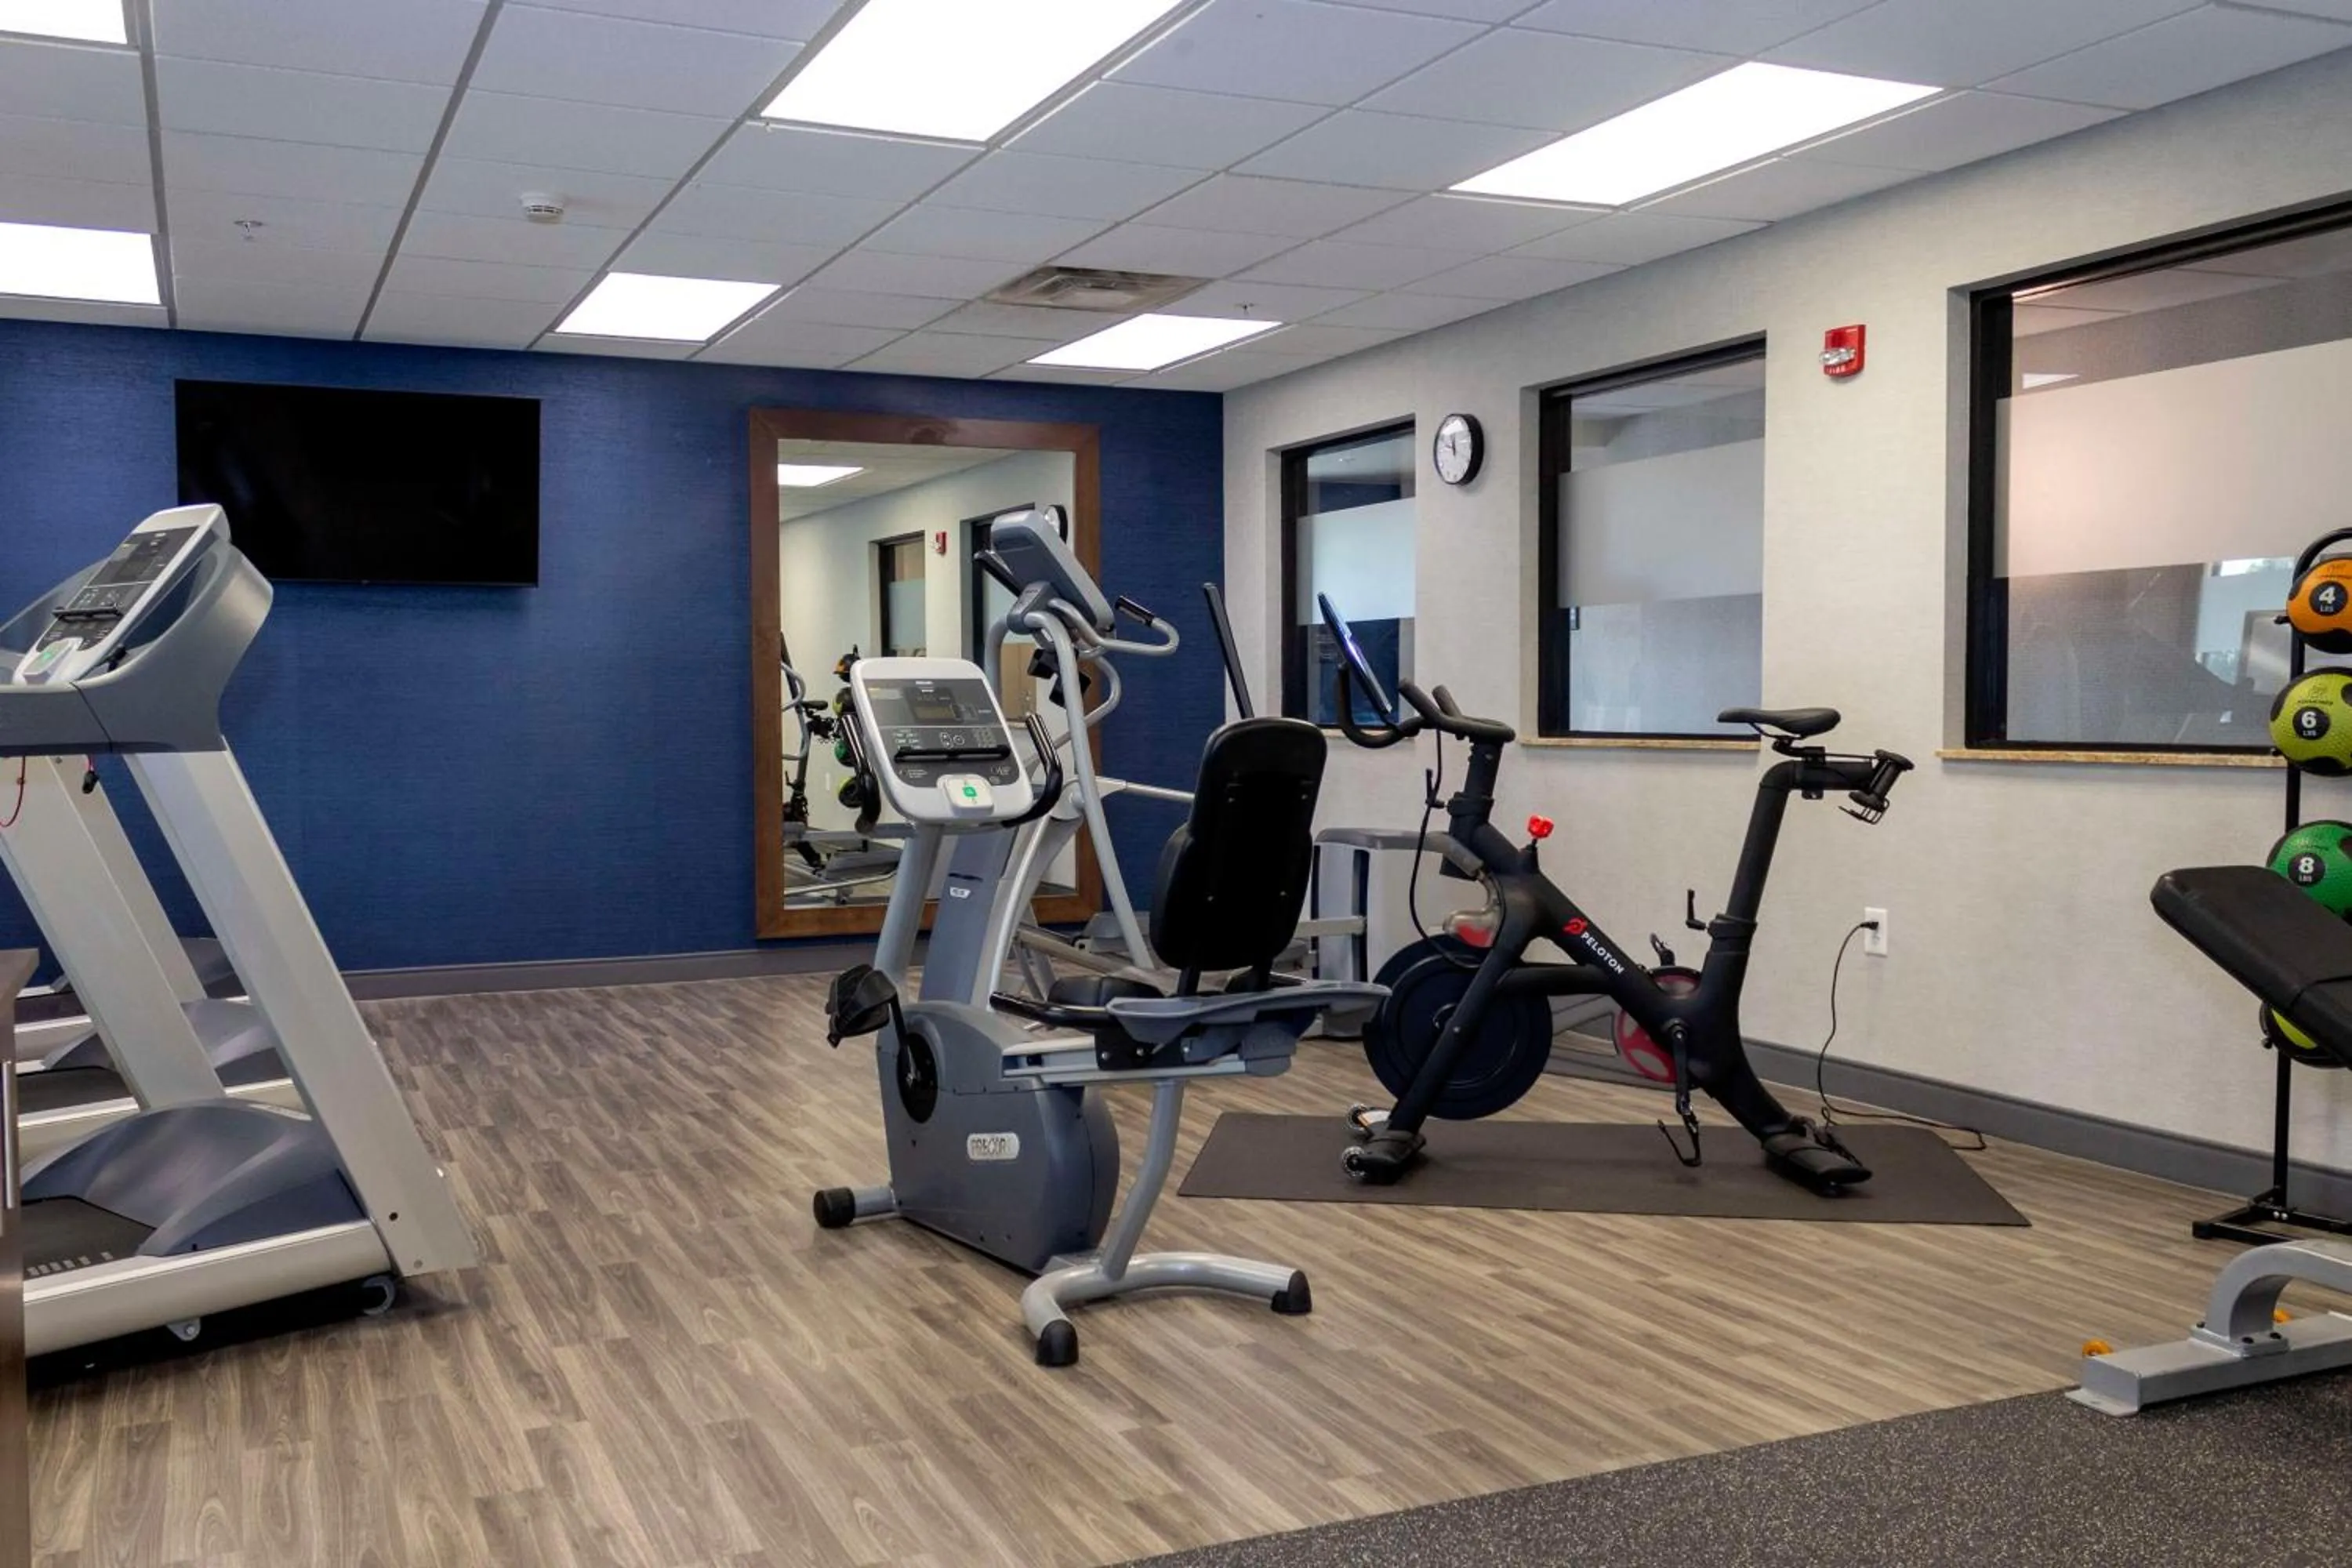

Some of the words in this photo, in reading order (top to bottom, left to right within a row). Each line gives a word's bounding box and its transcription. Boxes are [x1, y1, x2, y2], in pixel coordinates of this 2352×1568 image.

[2318, 586, 2336, 604] 4
[2301, 711, 2317, 728] 6
[2299, 857, 2314, 873] 8
[1581, 931, 1624, 974] PELOTON
